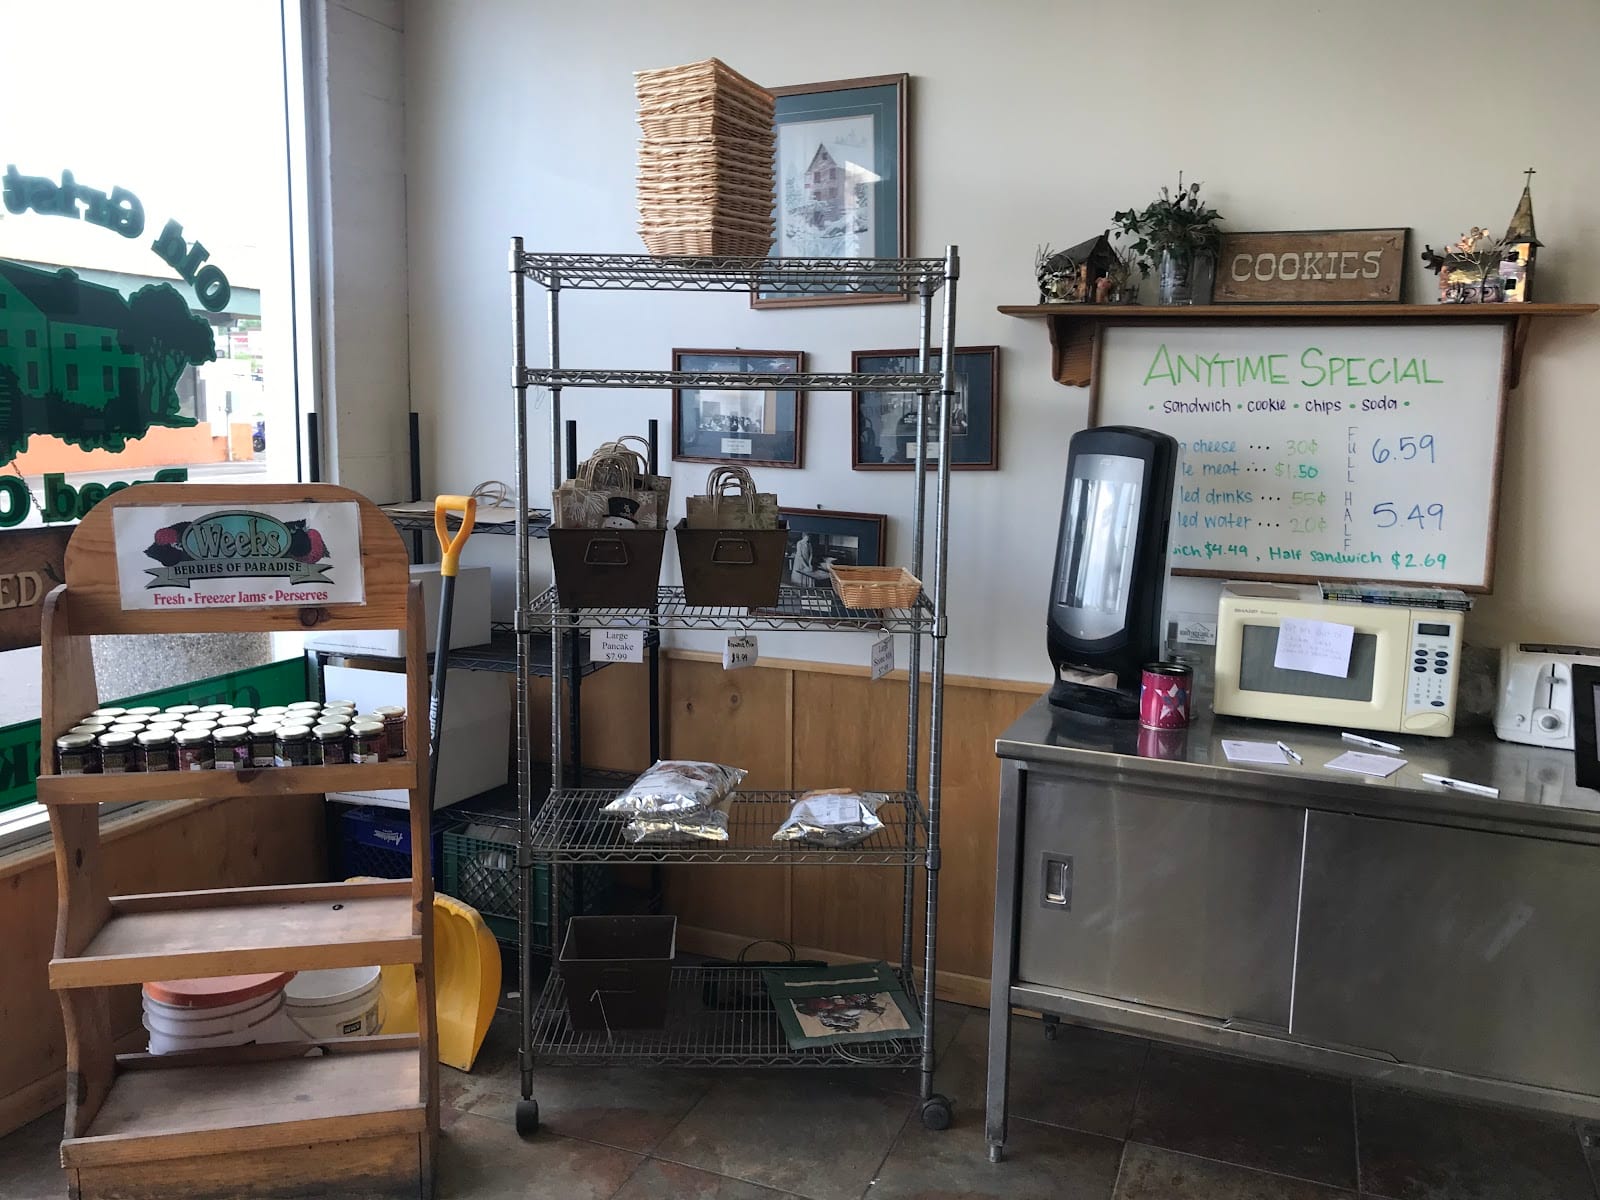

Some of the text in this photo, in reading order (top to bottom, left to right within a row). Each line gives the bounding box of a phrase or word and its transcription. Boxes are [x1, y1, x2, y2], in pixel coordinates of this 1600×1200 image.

[1231, 248, 1384, 282] COOKIES
[1143, 343, 1444, 387] ANYTIME SPECIAL
[1163, 396, 1397, 415] sandwich cookie chips soda
[1193, 439, 1237, 454] cheese
[1372, 434, 1435, 464] 6.59
[1202, 460, 1241, 476] meat
[1274, 461, 1319, 480] $1.50
[1205, 488, 1254, 505] drinks
[1204, 512, 1252, 529] water
[1373, 502, 1444, 531] 5.49
[192, 517, 281, 558] Weeks
[1269, 546, 1302, 560] Half
[1311, 550, 1382, 564] sandwich
[174, 562, 302, 575] BERRIES OF PARADISE
[154, 589, 328, 605] Fresh Freezer Jams Perserves
[606, 631, 629, 641] Large
[602, 641, 634, 651] Pancake
[606, 652, 628, 661] $7.99
